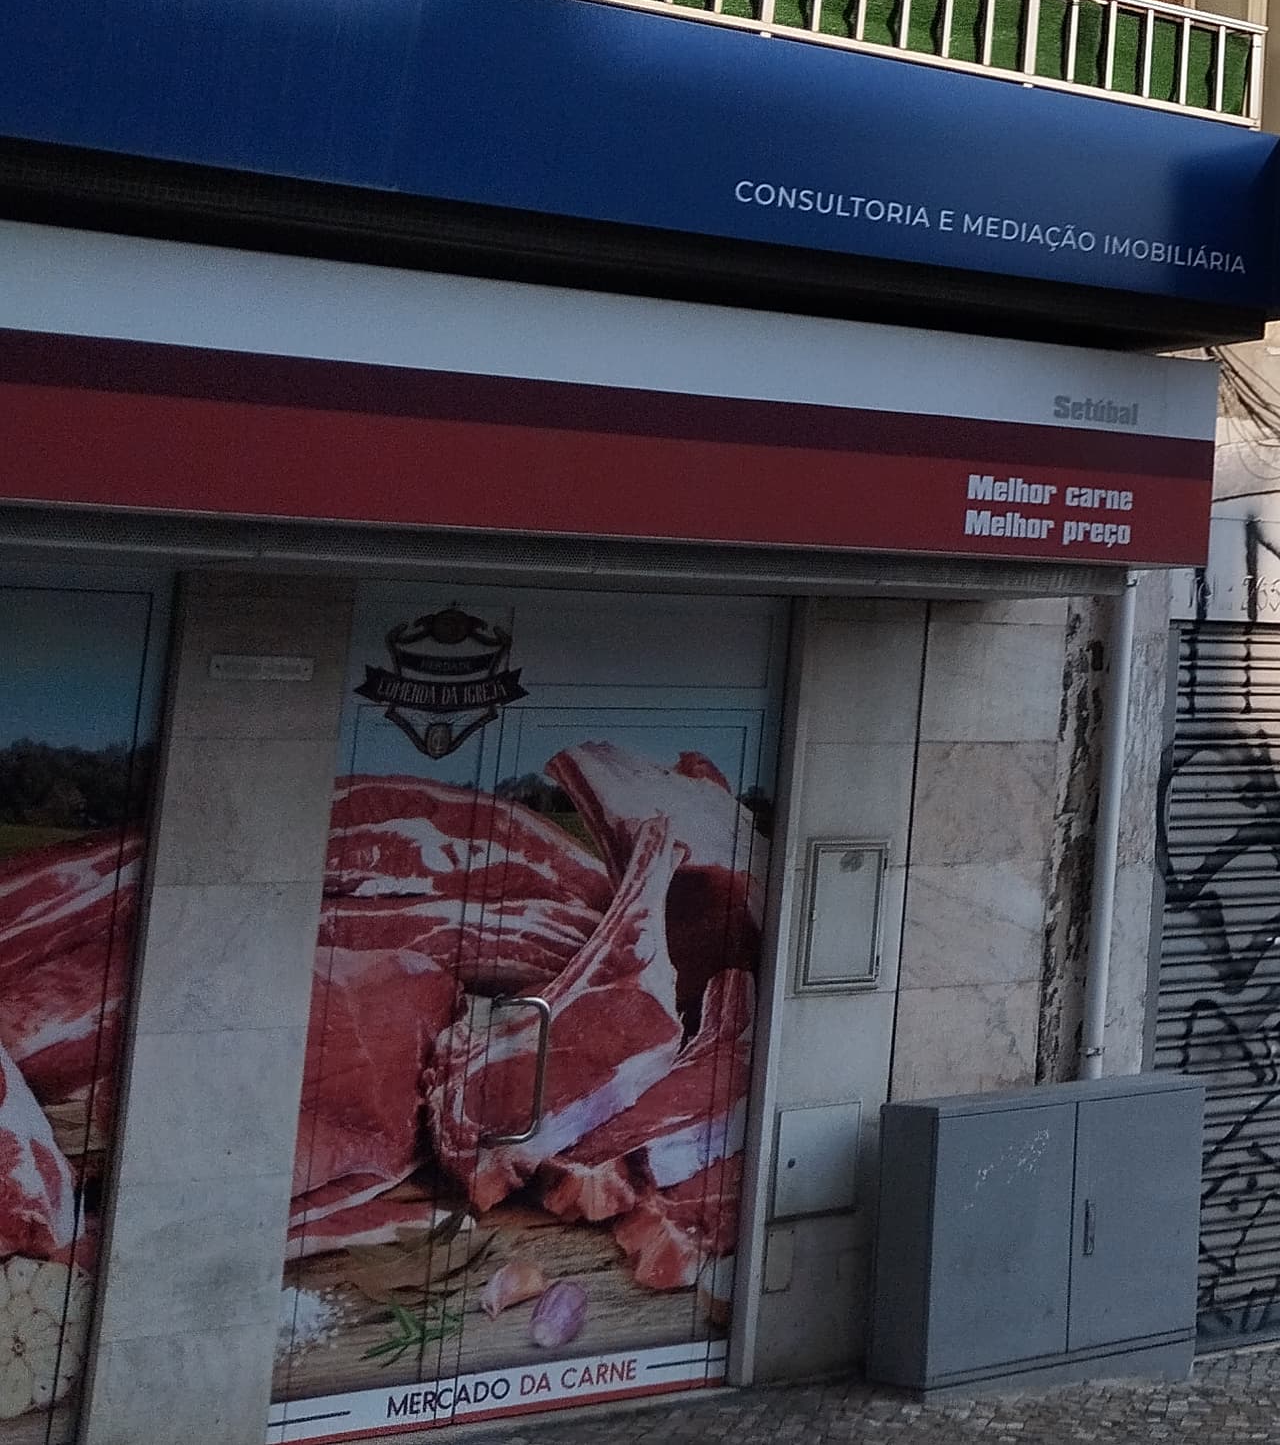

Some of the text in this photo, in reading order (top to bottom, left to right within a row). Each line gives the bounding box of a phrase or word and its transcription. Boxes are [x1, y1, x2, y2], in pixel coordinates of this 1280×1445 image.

[735, 180, 1246, 274] CONSULTORIA E MEDIAÇÃO IMOBILIÁRIA
[1053, 395, 1138, 425] Setúbal
[967, 474, 1133, 511] Melhor carne
[965, 509, 1131, 548] Melhor preço
[386, 1359, 638, 1418] MERCADO DA CARNE
